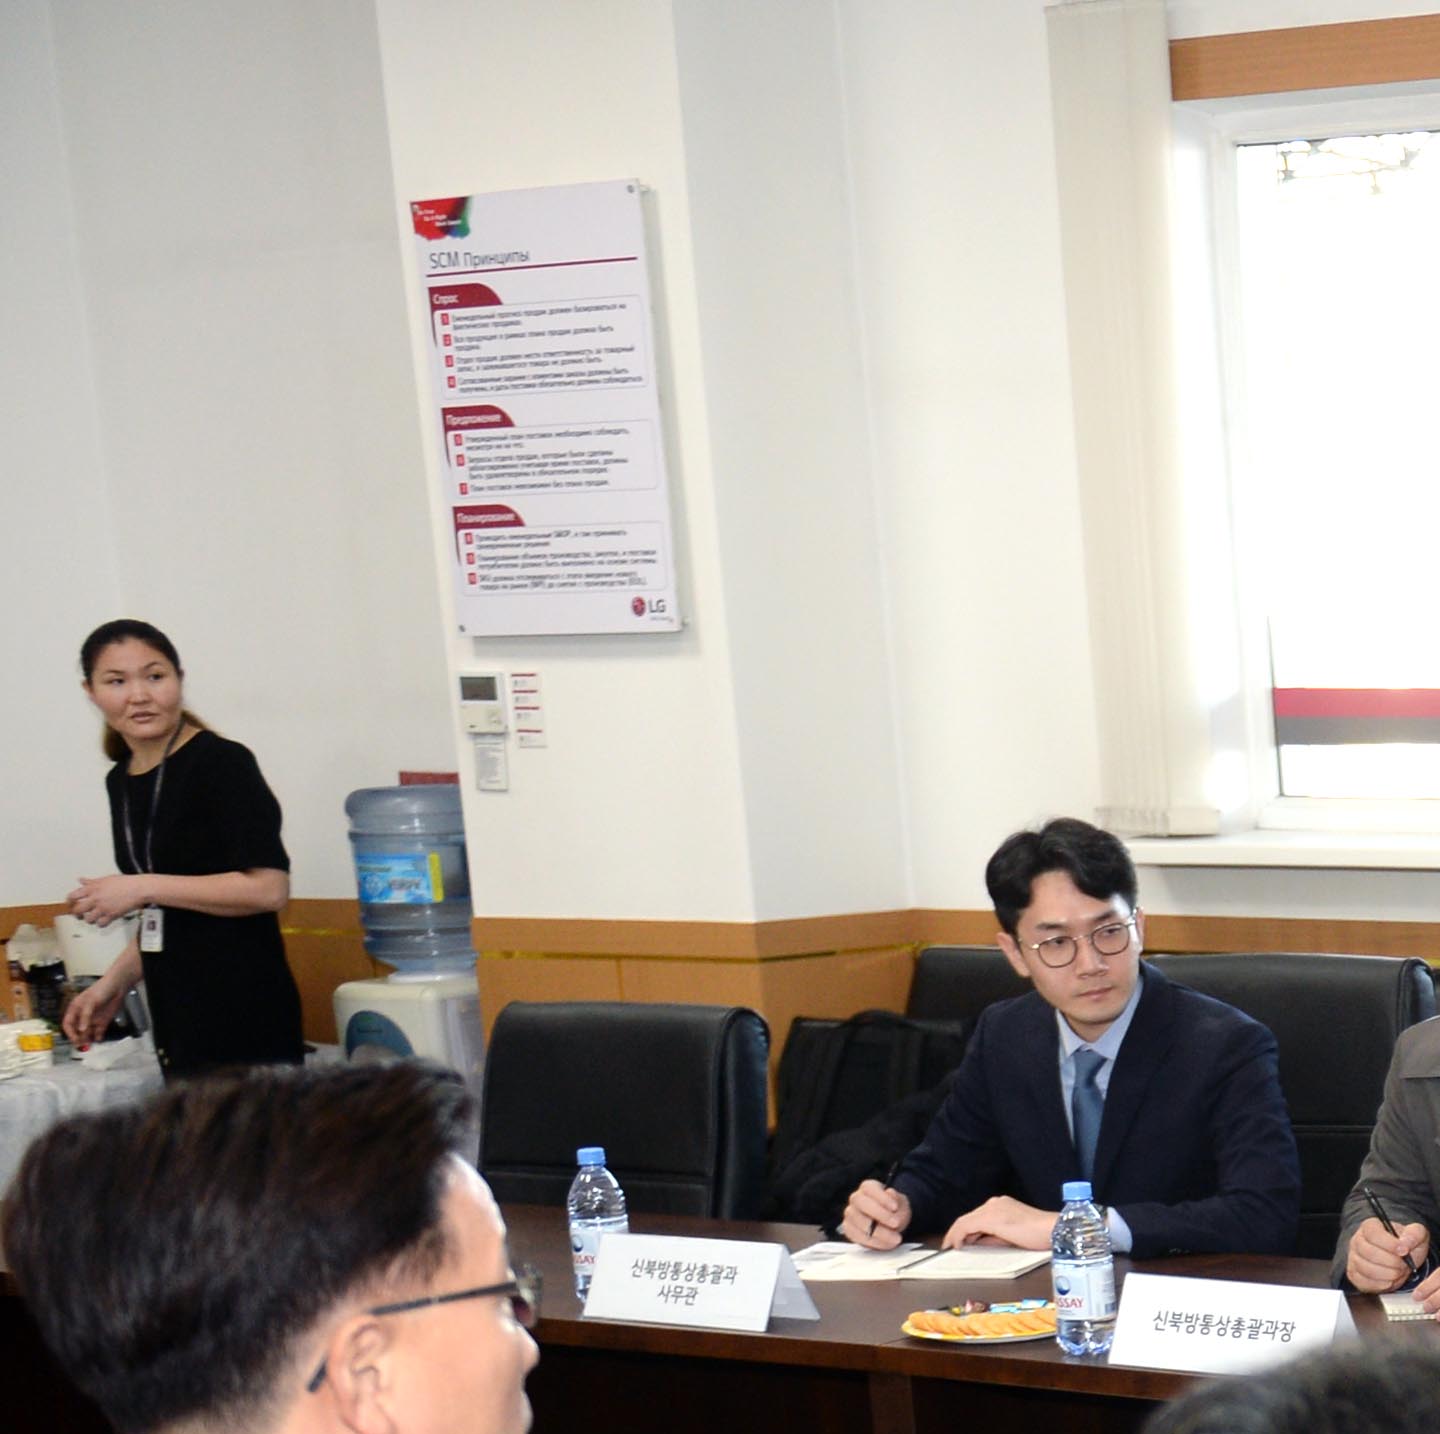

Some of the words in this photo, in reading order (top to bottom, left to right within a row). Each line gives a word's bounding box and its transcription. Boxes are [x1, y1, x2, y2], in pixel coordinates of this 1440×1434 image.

[429, 251, 460, 269] SCM
[463, 251, 530, 269] Принципы
[649, 600, 667, 614] LG
[631, 1258, 738, 1286] 신북방통상총괄과
[657, 1284, 698, 1307] 사무관
[1153, 1310, 1297, 1343] 신북방통상총괄과장
